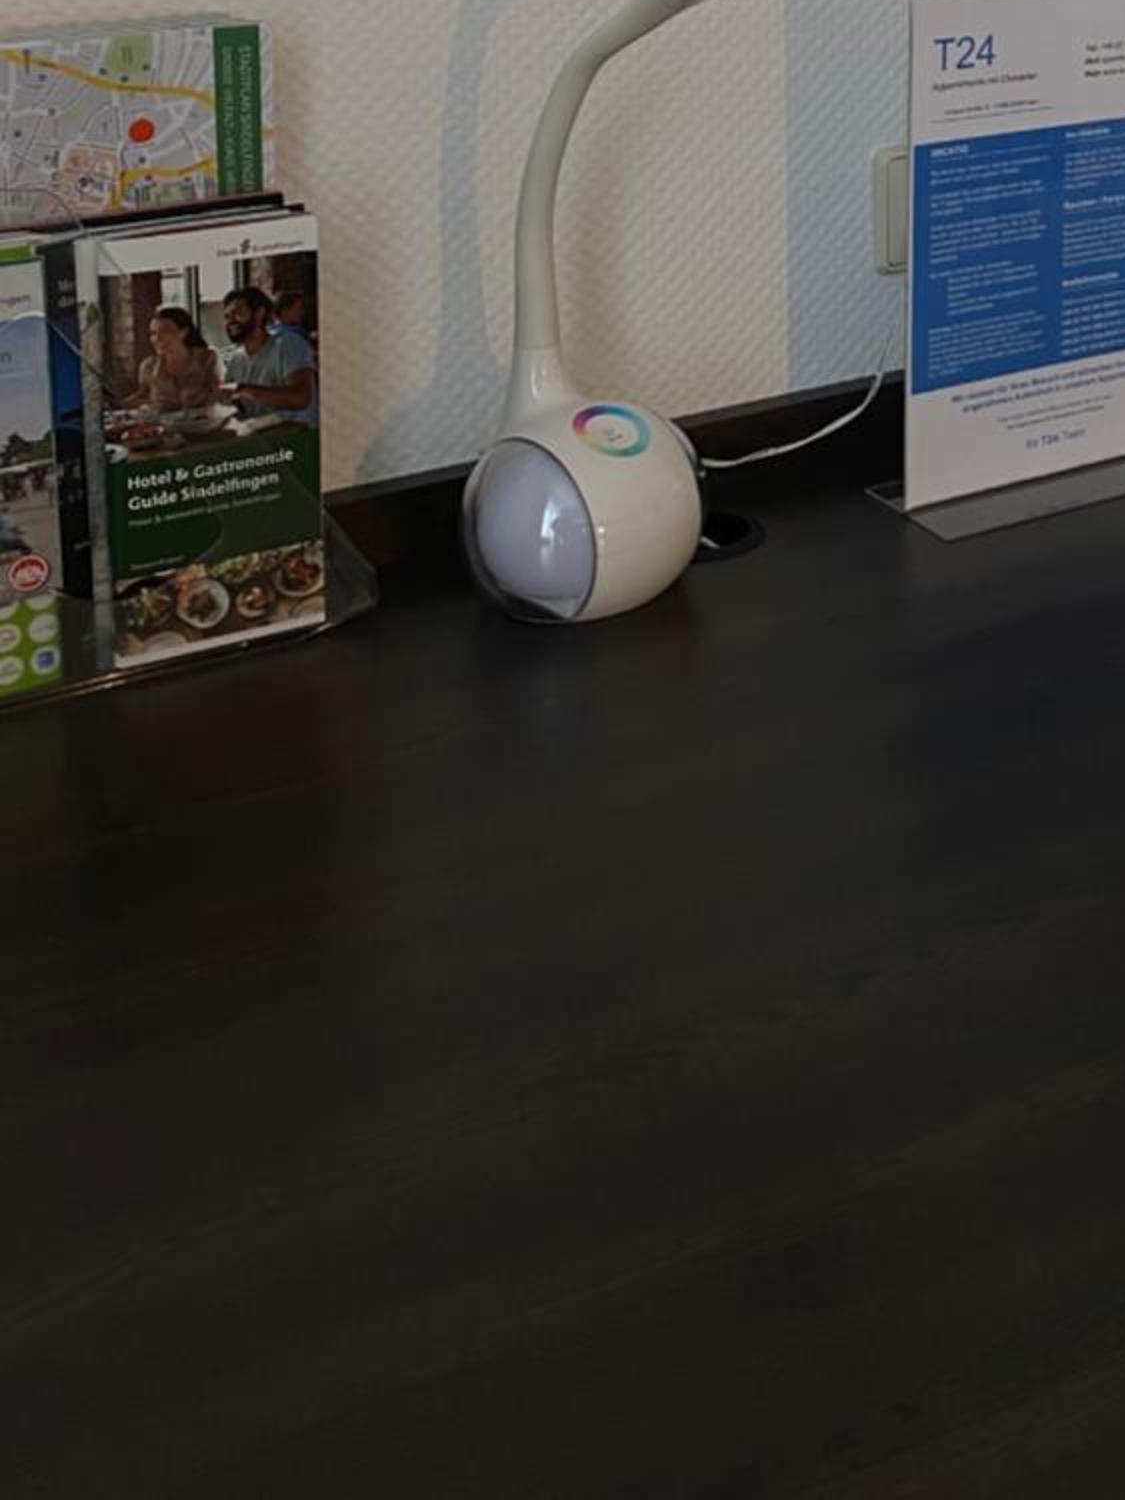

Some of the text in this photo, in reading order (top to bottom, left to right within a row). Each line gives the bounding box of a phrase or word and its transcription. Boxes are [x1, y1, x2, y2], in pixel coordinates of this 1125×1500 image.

[933, 34, 996, 72] T24
[127, 447, 294, 490] Hotel & Gastronomie
[127, 472, 280, 511] Guide Sindelfingen
